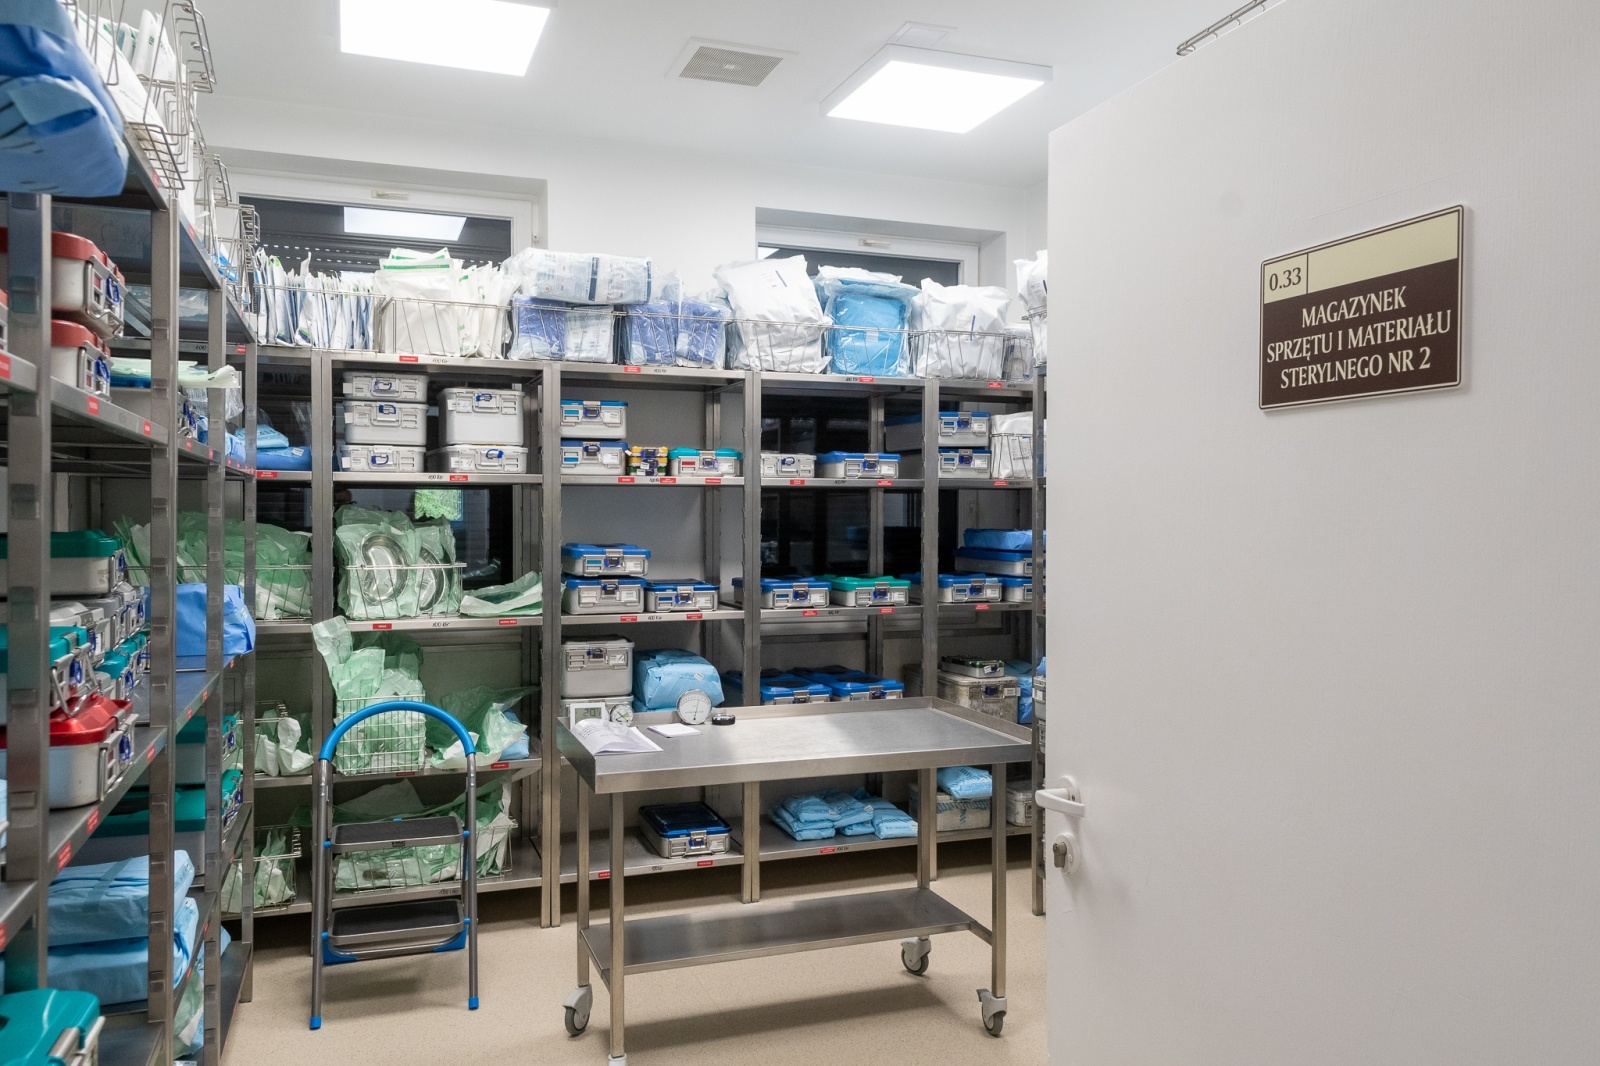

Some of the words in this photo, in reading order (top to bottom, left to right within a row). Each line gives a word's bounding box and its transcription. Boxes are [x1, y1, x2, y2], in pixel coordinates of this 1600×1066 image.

[1269, 267, 1302, 291] 0.33
[1301, 286, 1407, 328] MAGAZYNEK
[1266, 332, 1333, 363] SPRZĘTU
[1337, 330, 1343, 351] I
[1348, 309, 1452, 349] MATERIAŁU
[1280, 354, 1383, 389] STERYLNEGO
[1388, 349, 1415, 374] NR
[1419, 346, 1431, 369] 2
